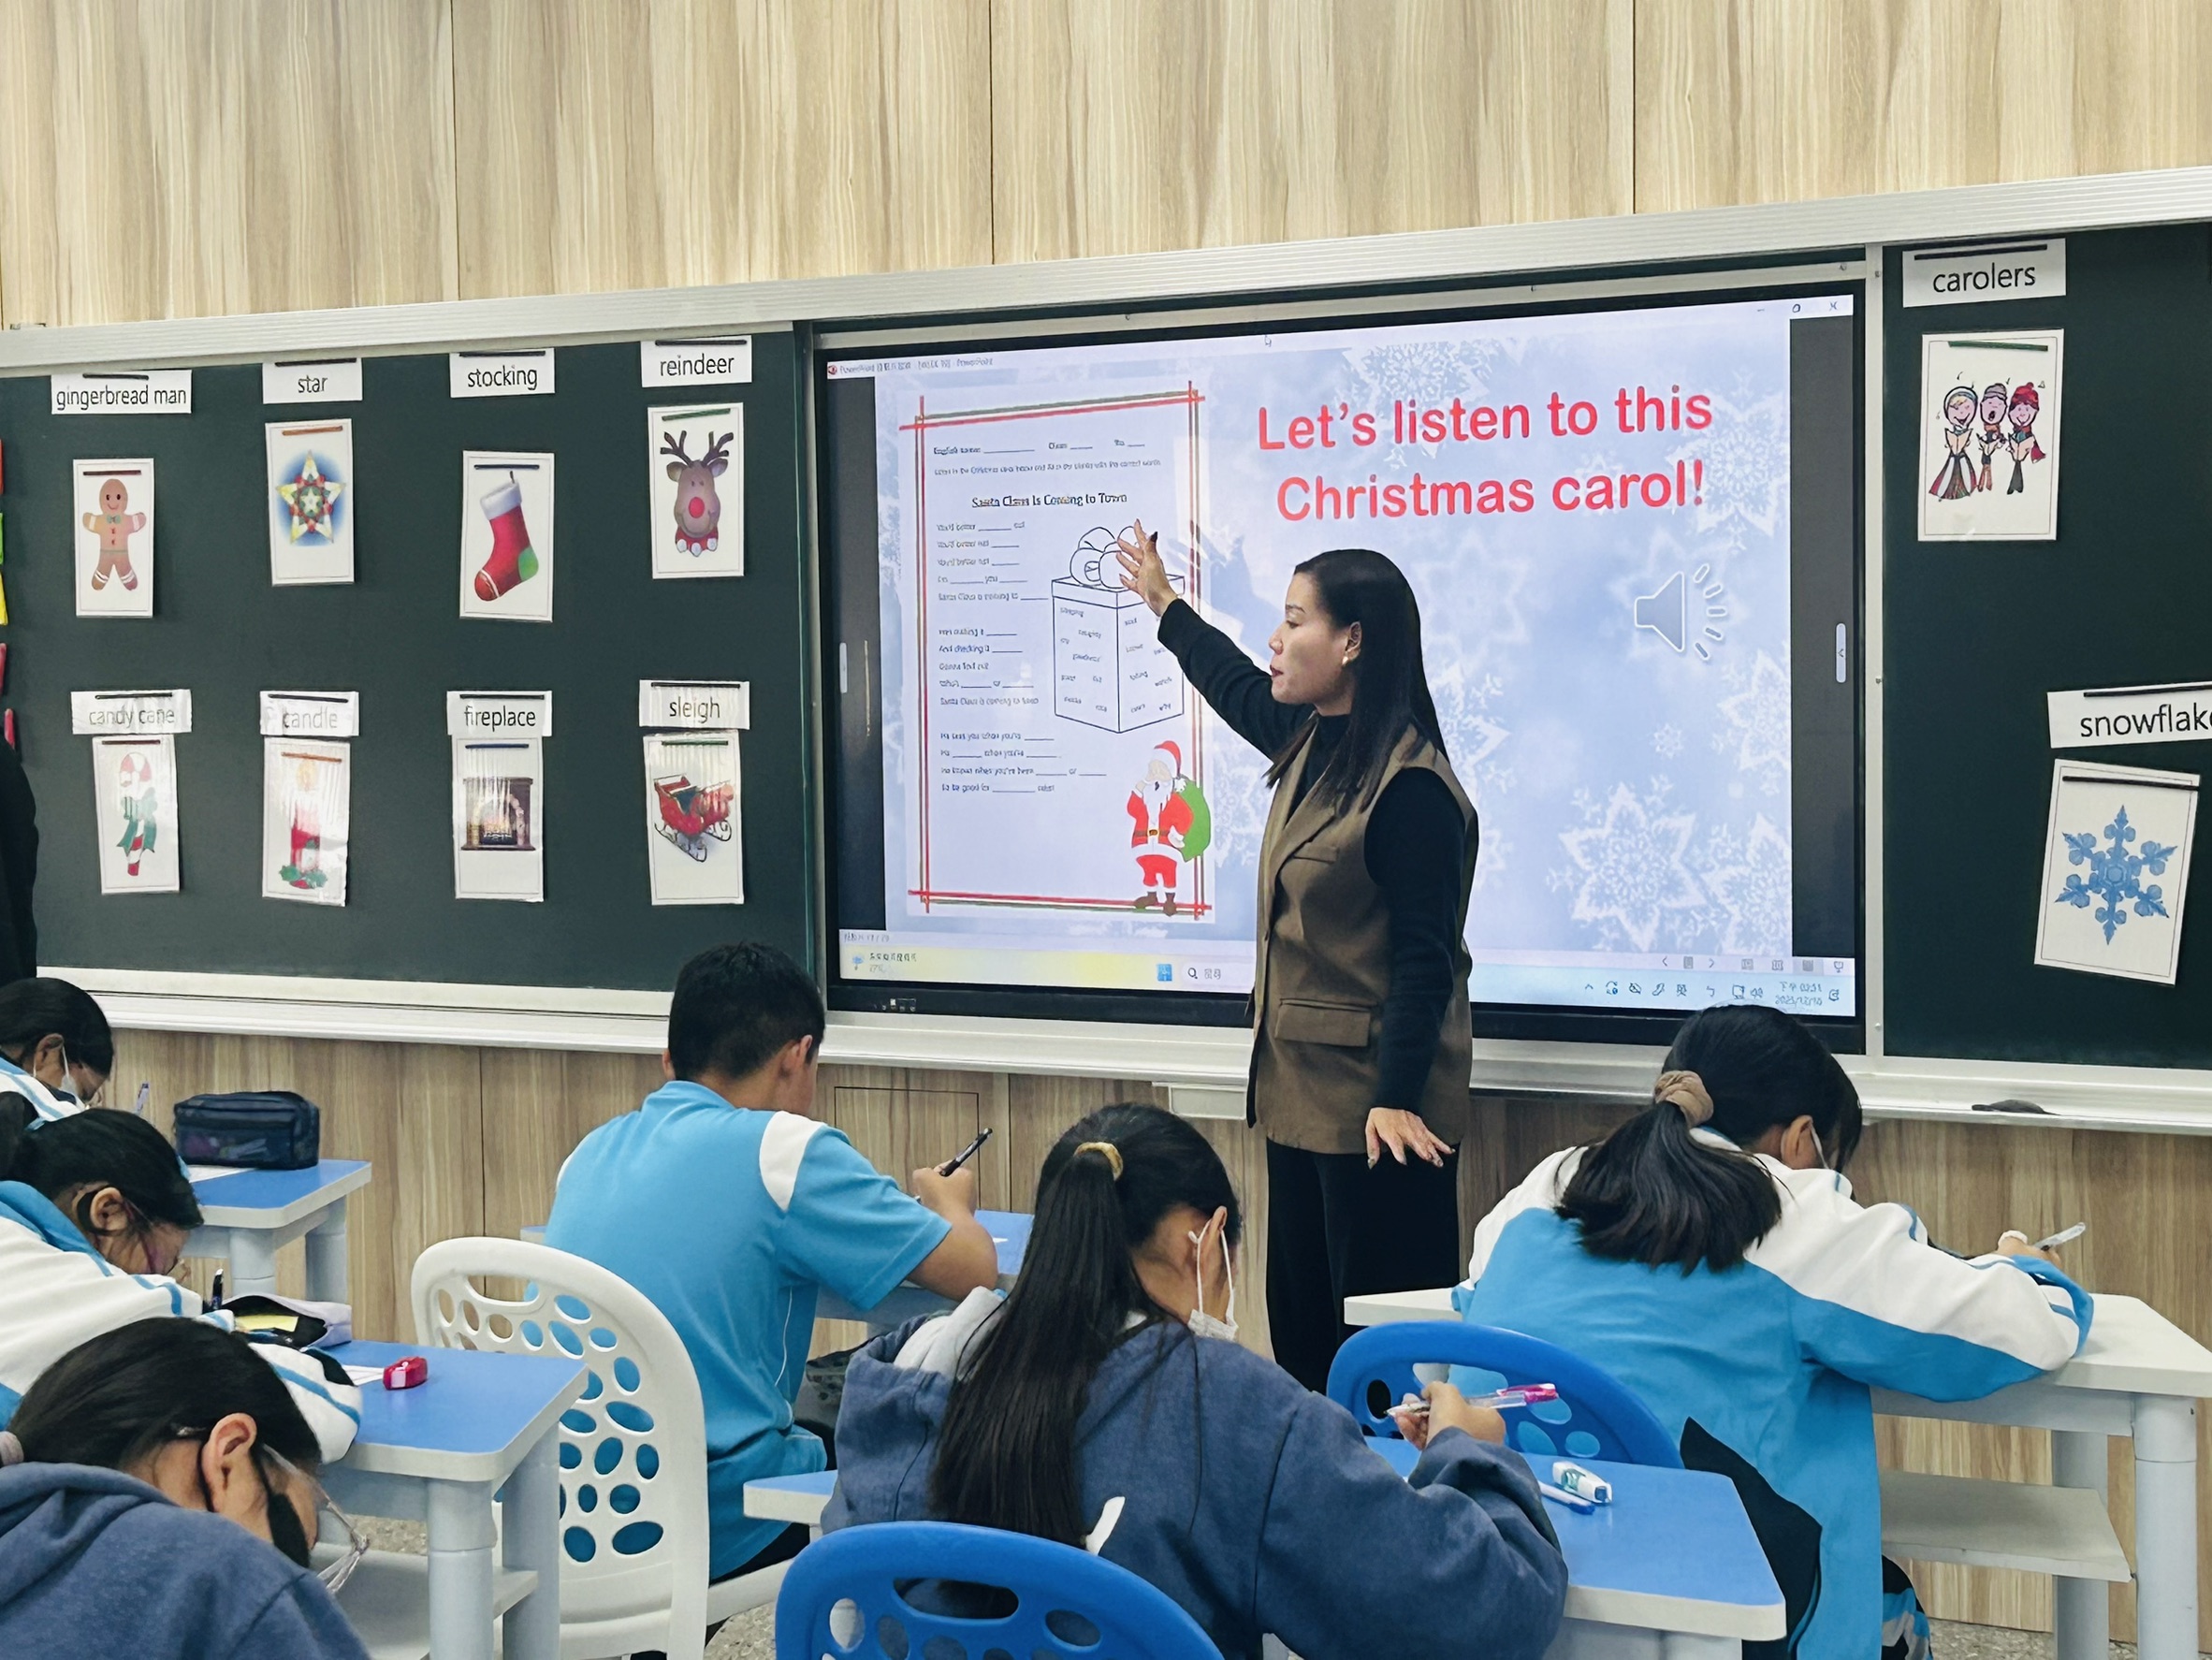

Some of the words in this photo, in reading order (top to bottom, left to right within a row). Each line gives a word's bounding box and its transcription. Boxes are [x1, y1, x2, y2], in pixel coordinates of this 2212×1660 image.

[1932, 262, 2036, 293] carolers
[468, 365, 538, 390] stocking
[660, 353, 735, 376] reindeer
[298, 374, 327, 393] star
[56, 385, 149, 411] gingerbread
[154, 389, 186, 404] man
[1259, 402, 1377, 451] Let’s
[1393, 398, 1530, 445] listen
[1547, 391, 1597, 437] to
[1614, 384, 1713, 433] this
[1085, 493, 1096, 504] to
[1277, 472, 1535, 521] Christmas
[1551, 459, 1704, 511] carol!
[89, 705, 133, 728] candy
[138, 708, 175, 724] cane
[283, 706, 338, 729] candle
[464, 706, 536, 732] fireplace
[669, 697, 720, 723] sleigh
[2080, 702, 2212, 737] snowflak
